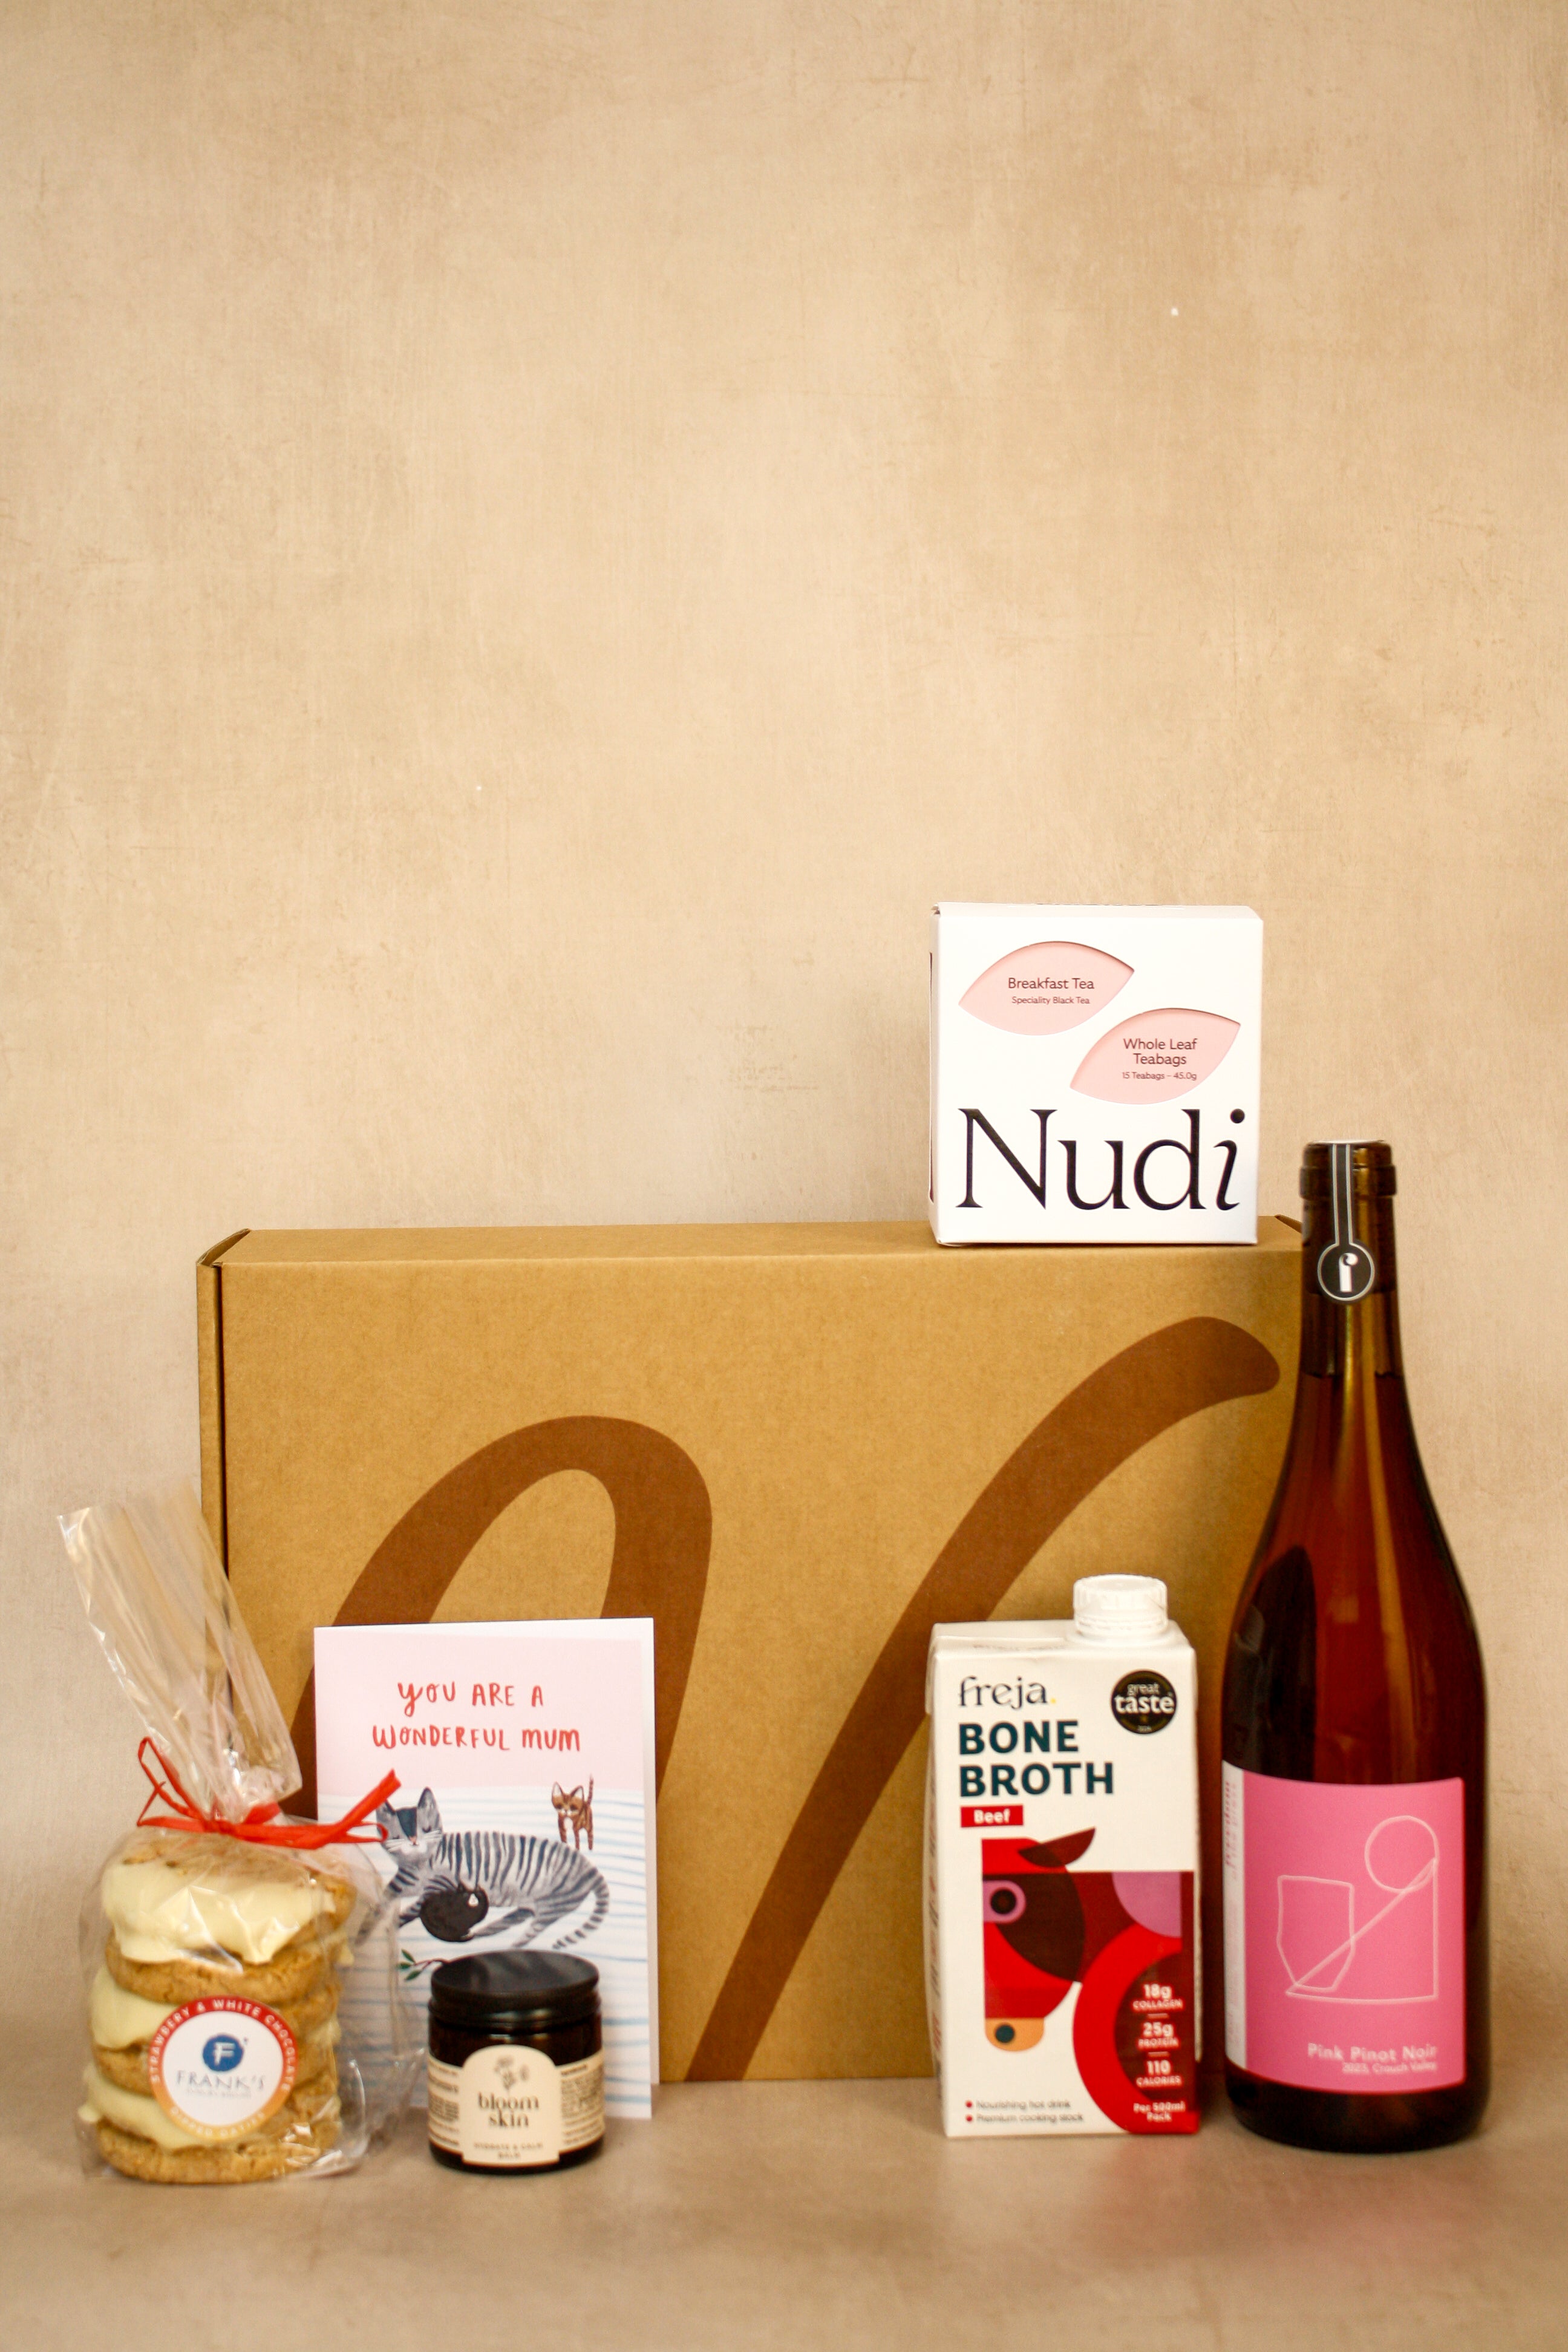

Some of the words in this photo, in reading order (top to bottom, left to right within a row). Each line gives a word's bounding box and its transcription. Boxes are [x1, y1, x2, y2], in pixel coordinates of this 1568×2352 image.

[1008, 977, 1069, 989] Breakfast
[1072, 978, 1094, 989] Tea
[1123, 1038, 1166, 1050] Whole
[1170, 1038, 1198, 1050] Leaf
[1133, 1053, 1187, 1067] Teabags
[1132, 1071, 1165, 1080] Teabags
[1173, 1072, 1197, 1080] 45.0g
[956, 1108, 1245, 1210] Nudi
[1128, 1683, 1159, 1696] great
[397, 1681, 456, 1717] YOU
[472, 1682, 515, 1707] ARE
[531, 1685, 543, 1707] A
[1114, 1694, 1175, 1714] taste
[372, 1724, 510, 1750] WONDERFUL
[522, 1728, 580, 1751] MUM
[958, 1720, 1079, 1755] BONE
[959, 1762, 1114, 1797] BROTH
[973, 1809, 1010, 1824] Beef
[1143, 1983, 1172, 2001] 18g
[1132, 1999, 1183, 2010] COLLAGEN
[1143, 2021, 1174, 2039] 25g
[197, 2001, 206, 2012] &
[213, 1998, 262, 2017] WHITE
[264, 2014, 296, 2092] CHOCOLATE
[1137, 2037, 1179, 2048] PROTEIN
[1308, 2042, 1344, 2061] Pink
[1350, 2046, 1396, 2063] Pinot
[1402, 2043, 1437, 2061] Noir
[1146, 2059, 1171, 2076] 110
[176, 2070, 266, 2091] FRANK'S
[1136, 2076, 1182, 2088] CALORIES
[477, 2092, 540, 2110] bloom
[976, 2100, 1027, 2110] Nourishing
[1133, 2102, 1151, 2114] Per
[488, 2109, 529, 2127] skin
[1019, 2114, 1056, 2123] cooking
[1146, 2111, 1172, 2122] Pack
